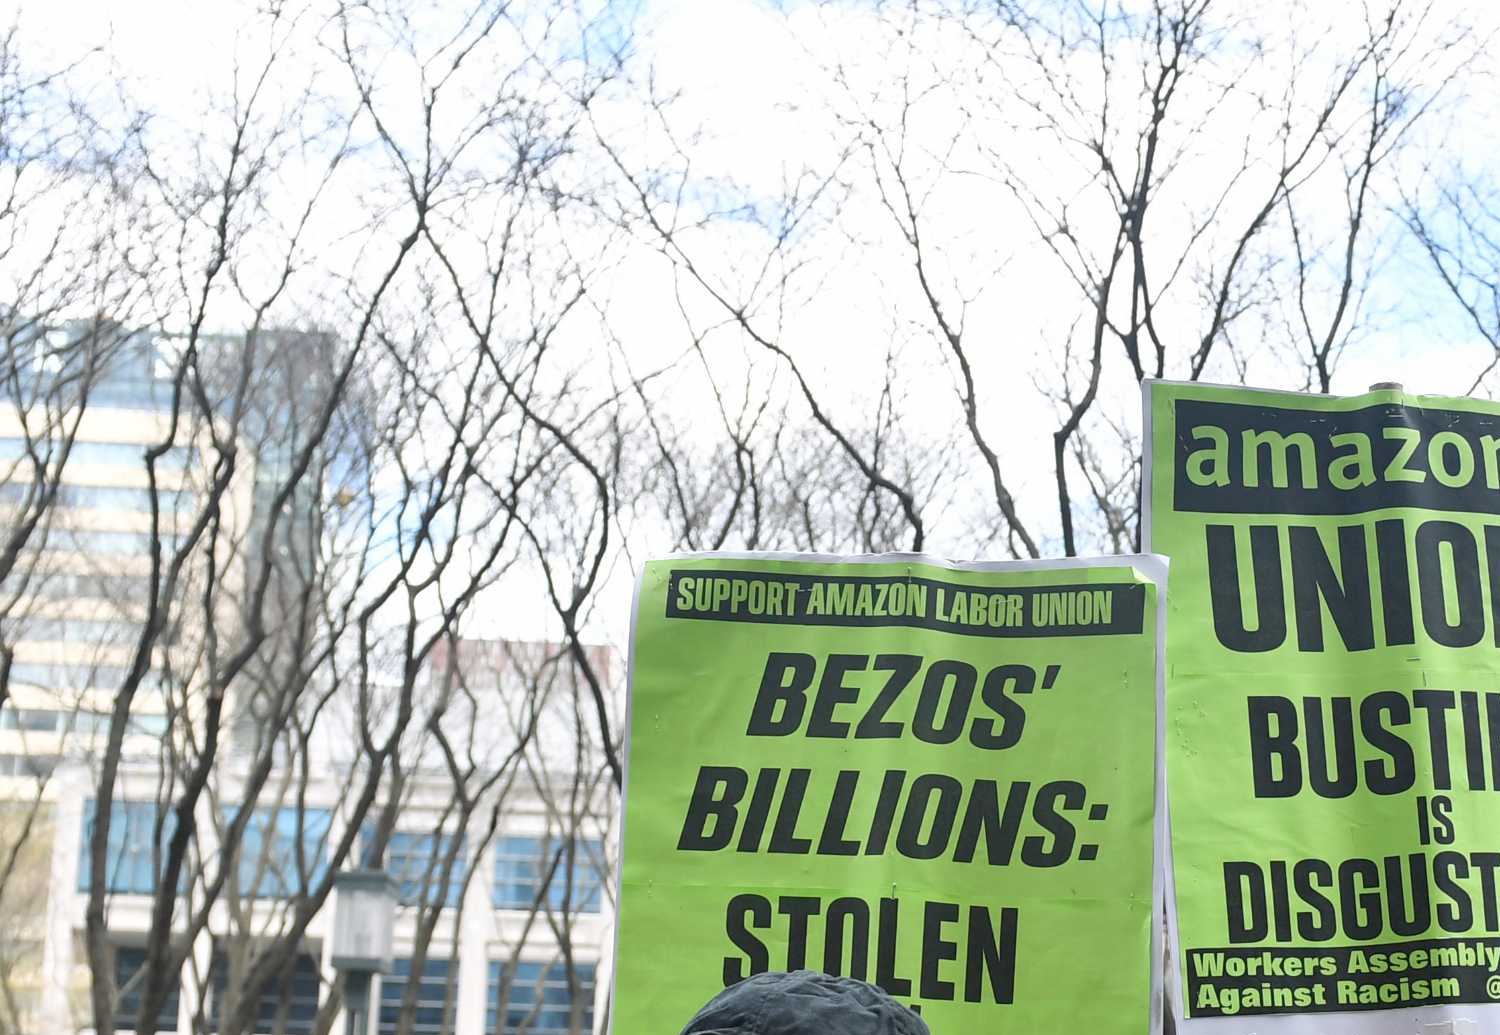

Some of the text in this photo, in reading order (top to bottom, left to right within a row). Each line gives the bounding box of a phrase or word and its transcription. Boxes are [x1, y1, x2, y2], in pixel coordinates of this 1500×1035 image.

[676, 576, 1113, 628] SUPPORT AMAZON LABOR UNION
[746, 651, 1062, 750] BEZOS'
[676, 765, 1109, 867] BILLIONS:
[1416, 795, 1456, 846] IS
[722, 893, 1019, 1005] STOLEN
[1193, 949, 1338, 978] Workers
[1196, 982, 1327, 1015] Against
[1337, 975, 1461, 1006] Racism
